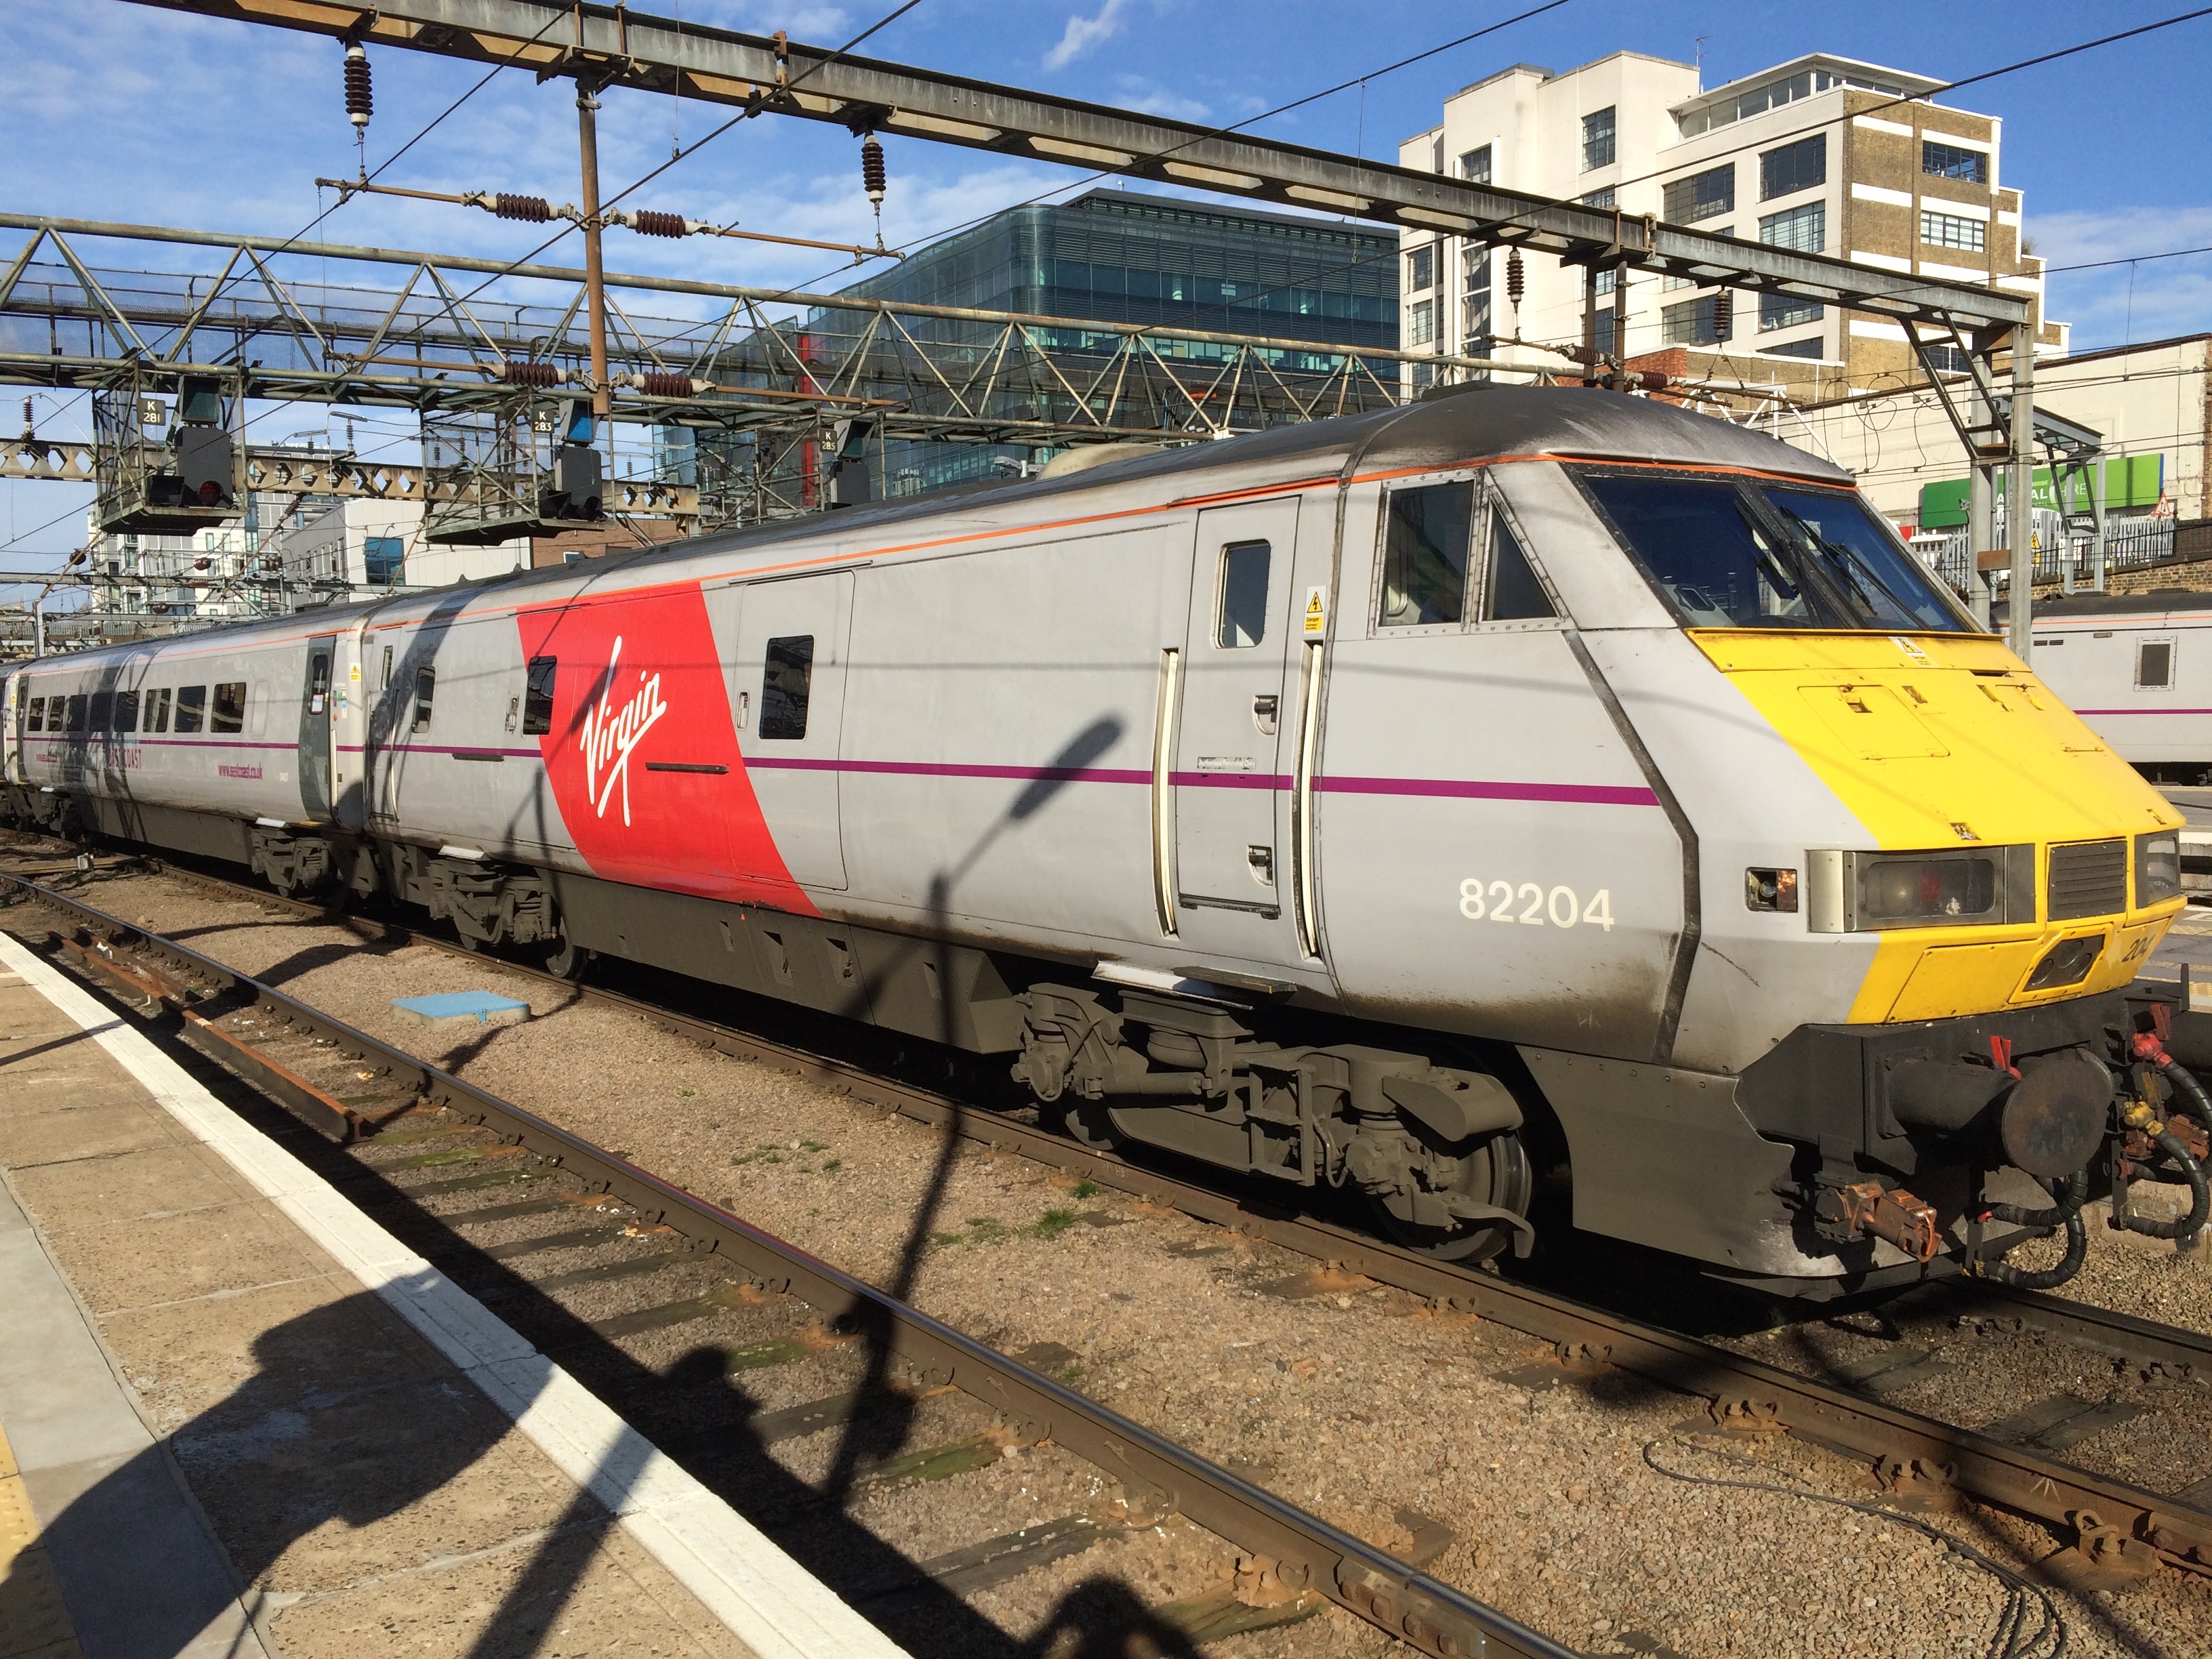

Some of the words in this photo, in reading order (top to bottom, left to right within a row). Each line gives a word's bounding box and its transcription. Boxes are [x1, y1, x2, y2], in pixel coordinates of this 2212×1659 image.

[147, 401, 155, 411] K
[144, 413, 160, 423] 281
[539, 411, 546, 420] K
[534, 422, 552, 431] 283
[825, 432, 832, 440] K
[822, 441, 836, 450] 285
[579, 635, 667, 827] Virgin
[1244, 759, 1255, 768] Only
[1460, 878, 1614, 932] 82204
[2121, 935, 2155, 962] 204
